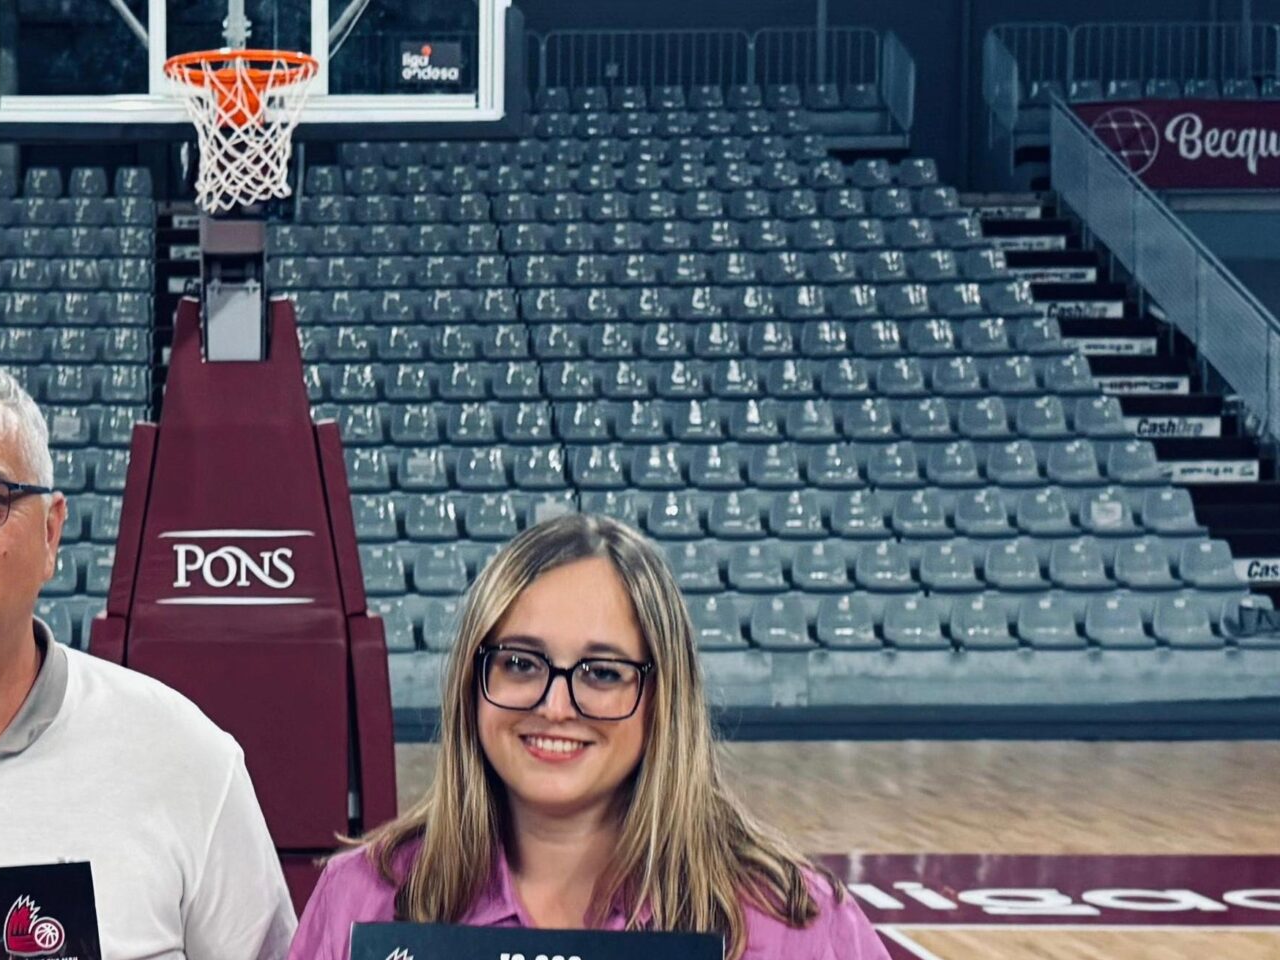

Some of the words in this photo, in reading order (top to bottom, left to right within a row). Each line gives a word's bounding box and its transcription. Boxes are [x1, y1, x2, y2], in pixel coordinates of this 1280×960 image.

[402, 51, 429, 67] liga
[402, 65, 459, 80] endesa
[172, 543, 296, 589] PONS
